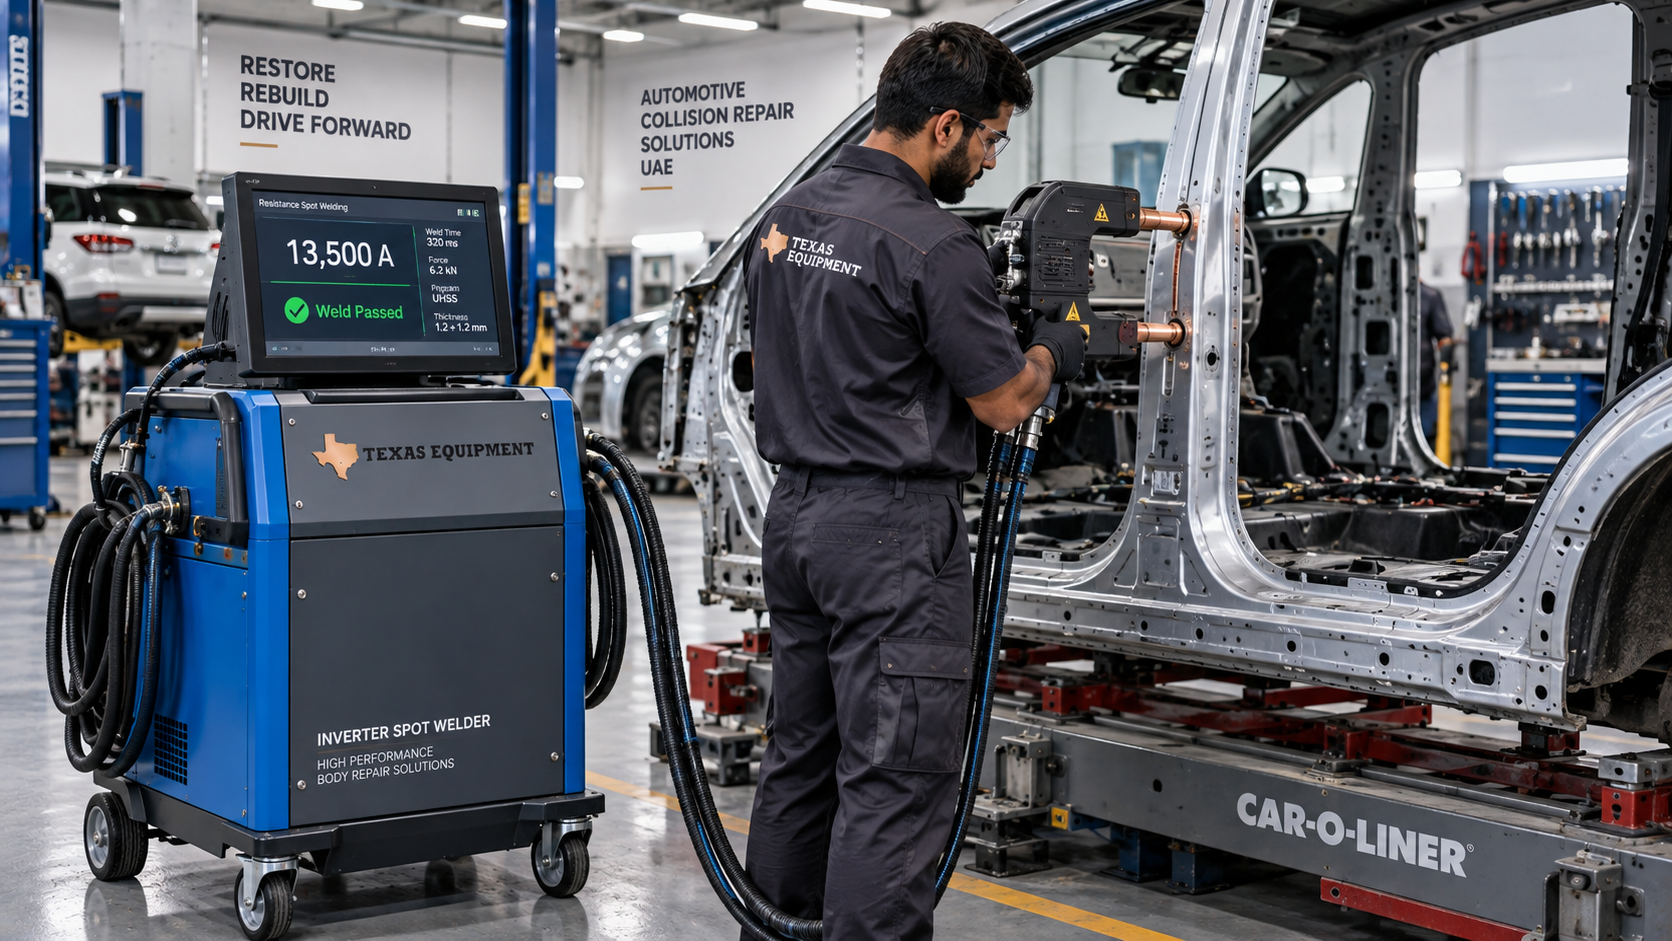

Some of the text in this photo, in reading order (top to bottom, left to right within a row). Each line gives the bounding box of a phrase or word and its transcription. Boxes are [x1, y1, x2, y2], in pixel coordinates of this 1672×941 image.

[240, 54, 336, 83] RESTORE
[240, 82, 330, 108] REBUILD
[640, 81, 746, 106] AUTOMOTIVE
[240, 109, 412, 141] DRIVE FORWARD
[640, 102, 795, 129] COLLISION REPAIR
[640, 131, 735, 153] SOLUTIONS
[640, 158, 674, 176] UAE
[301, 201, 318, 211] Spot
[319, 202, 349, 213] Welding
[425, 228, 462, 237] Weld Time
[426, 237, 444, 247] 320
[286, 238, 396, 270] 13,500 A
[791, 236, 835, 256] TEXAS
[428, 256, 449, 264] Force
[429, 266, 458, 275] 6.2 kN
[786, 250, 862, 277] EQUIPMENT
[432, 293, 458, 303] UHSS
[315, 304, 404, 320] Weld Passed
[435, 322, 449, 332] 1.2
[457, 323, 471, 332] 1.2
[362, 442, 535, 462] TEXAS EQUIPMENT
[317, 713, 491, 747] INVERTER SPOT WELDER
[317, 745, 434, 771] HIGH PERFORMANCE
[317, 758, 455, 785] BODY REPAIR SOLUTIONS
